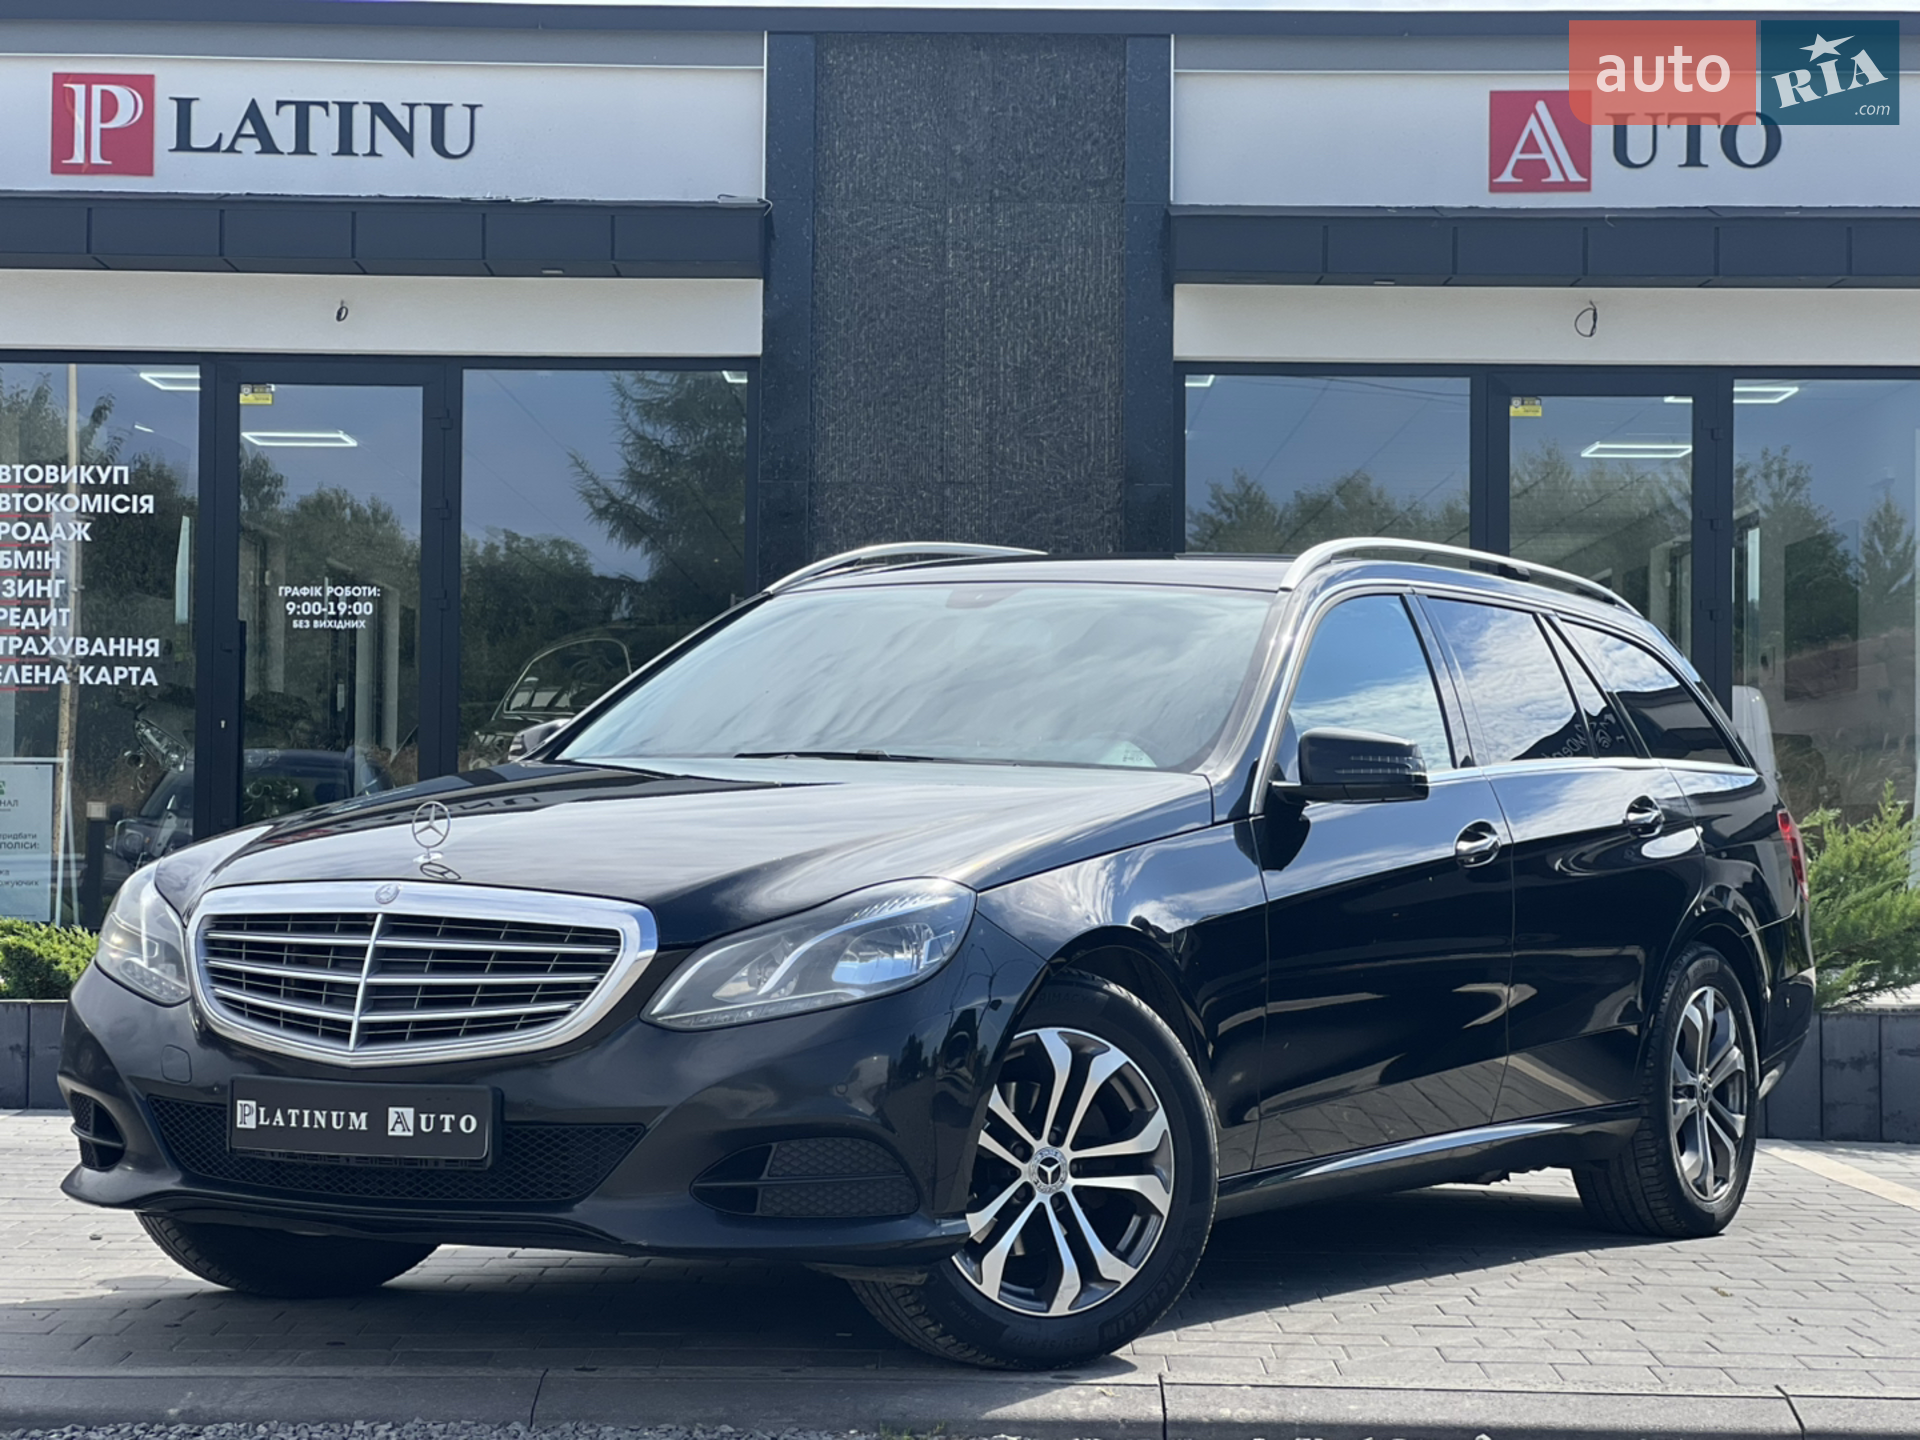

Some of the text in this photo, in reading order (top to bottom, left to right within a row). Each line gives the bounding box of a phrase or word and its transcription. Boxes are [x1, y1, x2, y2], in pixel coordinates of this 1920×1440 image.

[278, 586, 381, 597] ГРАФІК РОБОТИ:
[285, 601, 373, 616] 9:00-19:00
[292, 619, 366, 630] БЕЗ ВИХІДНИХ
[0, 665, 159, 686] ЛЕНА КАРТА
[236, 1100, 478, 1137] PLATINUM AUTO
[1103, 1253, 1187, 1339] MICHELIN
